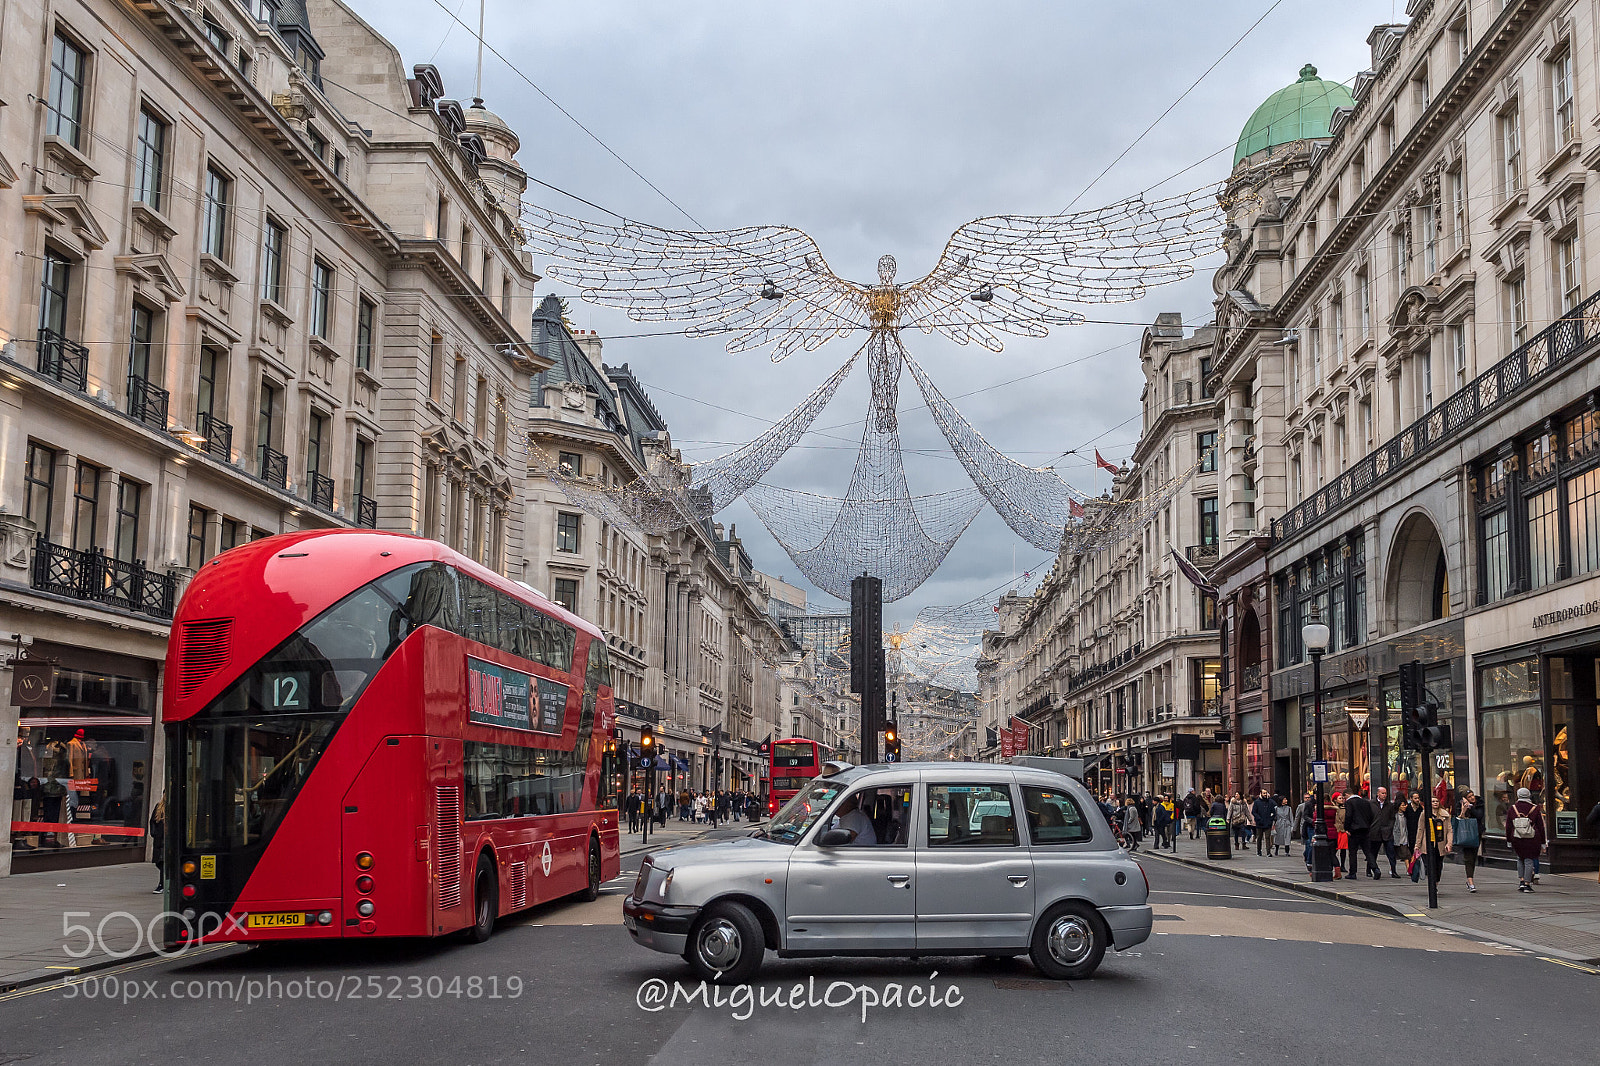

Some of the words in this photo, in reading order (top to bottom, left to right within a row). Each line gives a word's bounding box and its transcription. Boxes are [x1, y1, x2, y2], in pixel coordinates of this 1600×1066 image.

[1532, 600, 1600, 629] ANTHROPOLOG
[273, 676, 299, 707] 12
[254, 915, 274, 926] LTZ
[276, 914, 299, 925] 1450
